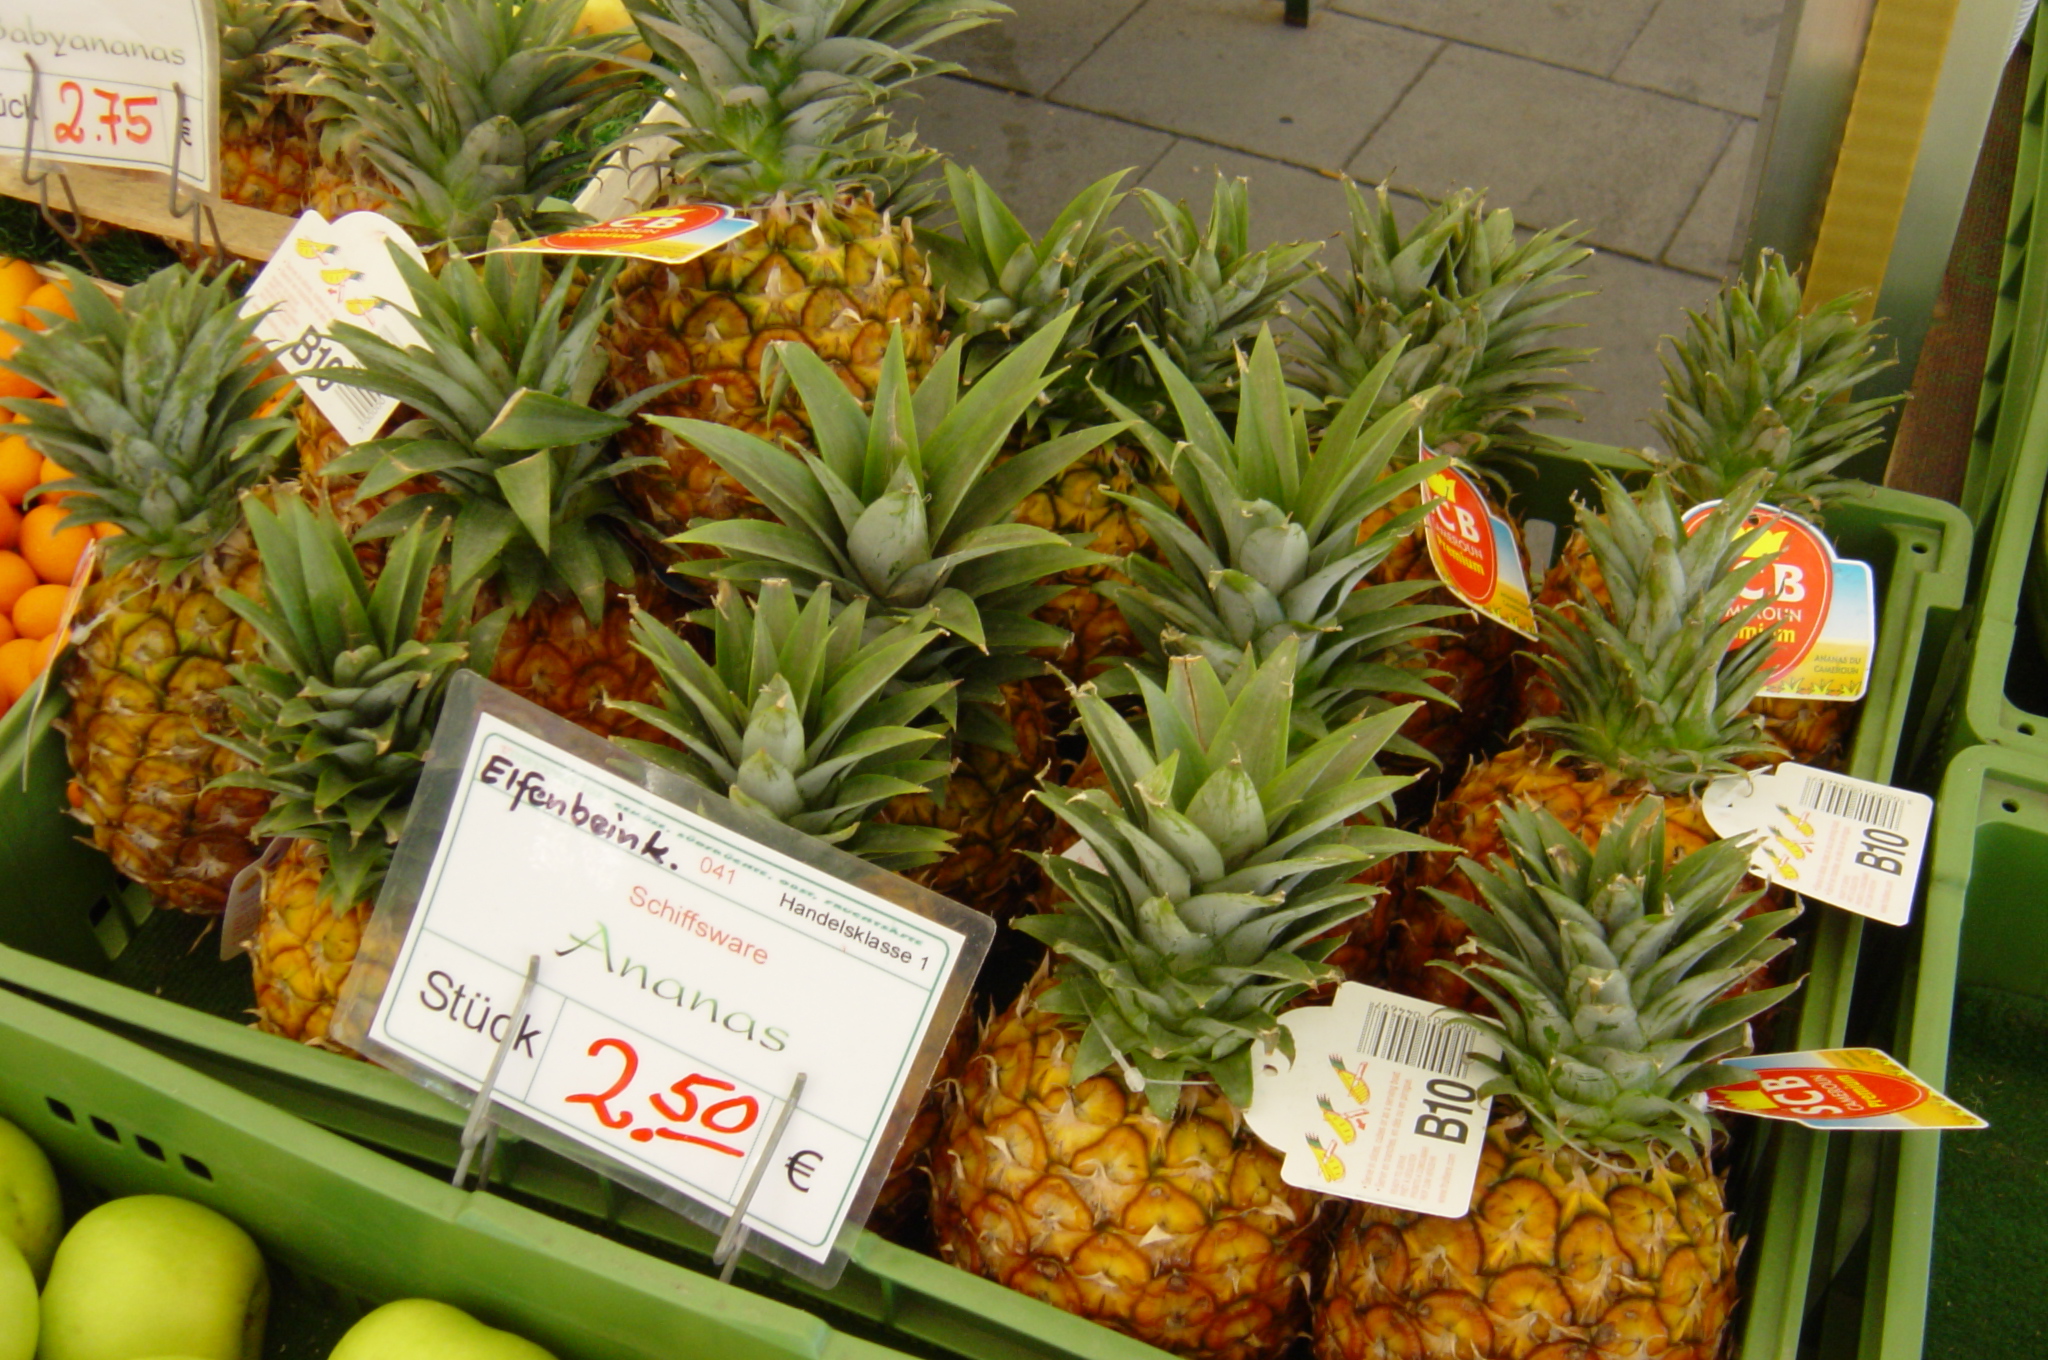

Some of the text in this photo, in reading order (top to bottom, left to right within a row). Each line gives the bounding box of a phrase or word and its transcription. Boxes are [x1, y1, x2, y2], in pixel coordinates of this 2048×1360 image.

[0, 17, 186, 65] abyananas
[54, 81, 158, 146] 2.75
[609, 216, 686, 229] CB
[1434, 498, 1480, 543] CB
[1436, 534, 1486, 576] Premium
[1732, 559, 1806, 603] CB
[700, 856, 736, 885] 041
[1855, 828, 1910, 877] B10
[629, 885, 769, 966] Schiffsware
[779, 892, 929, 972] Handelsklasse 1
[554, 921, 790, 1053] Ananas
[420, 970, 542, 1059] Stück
[1414, 1078, 1478, 1145] B10
[1760, 1075, 1844, 1115] SCB
[1835, 1074, 1888, 1108] Premium
[783, 1149, 824, 1193] €
